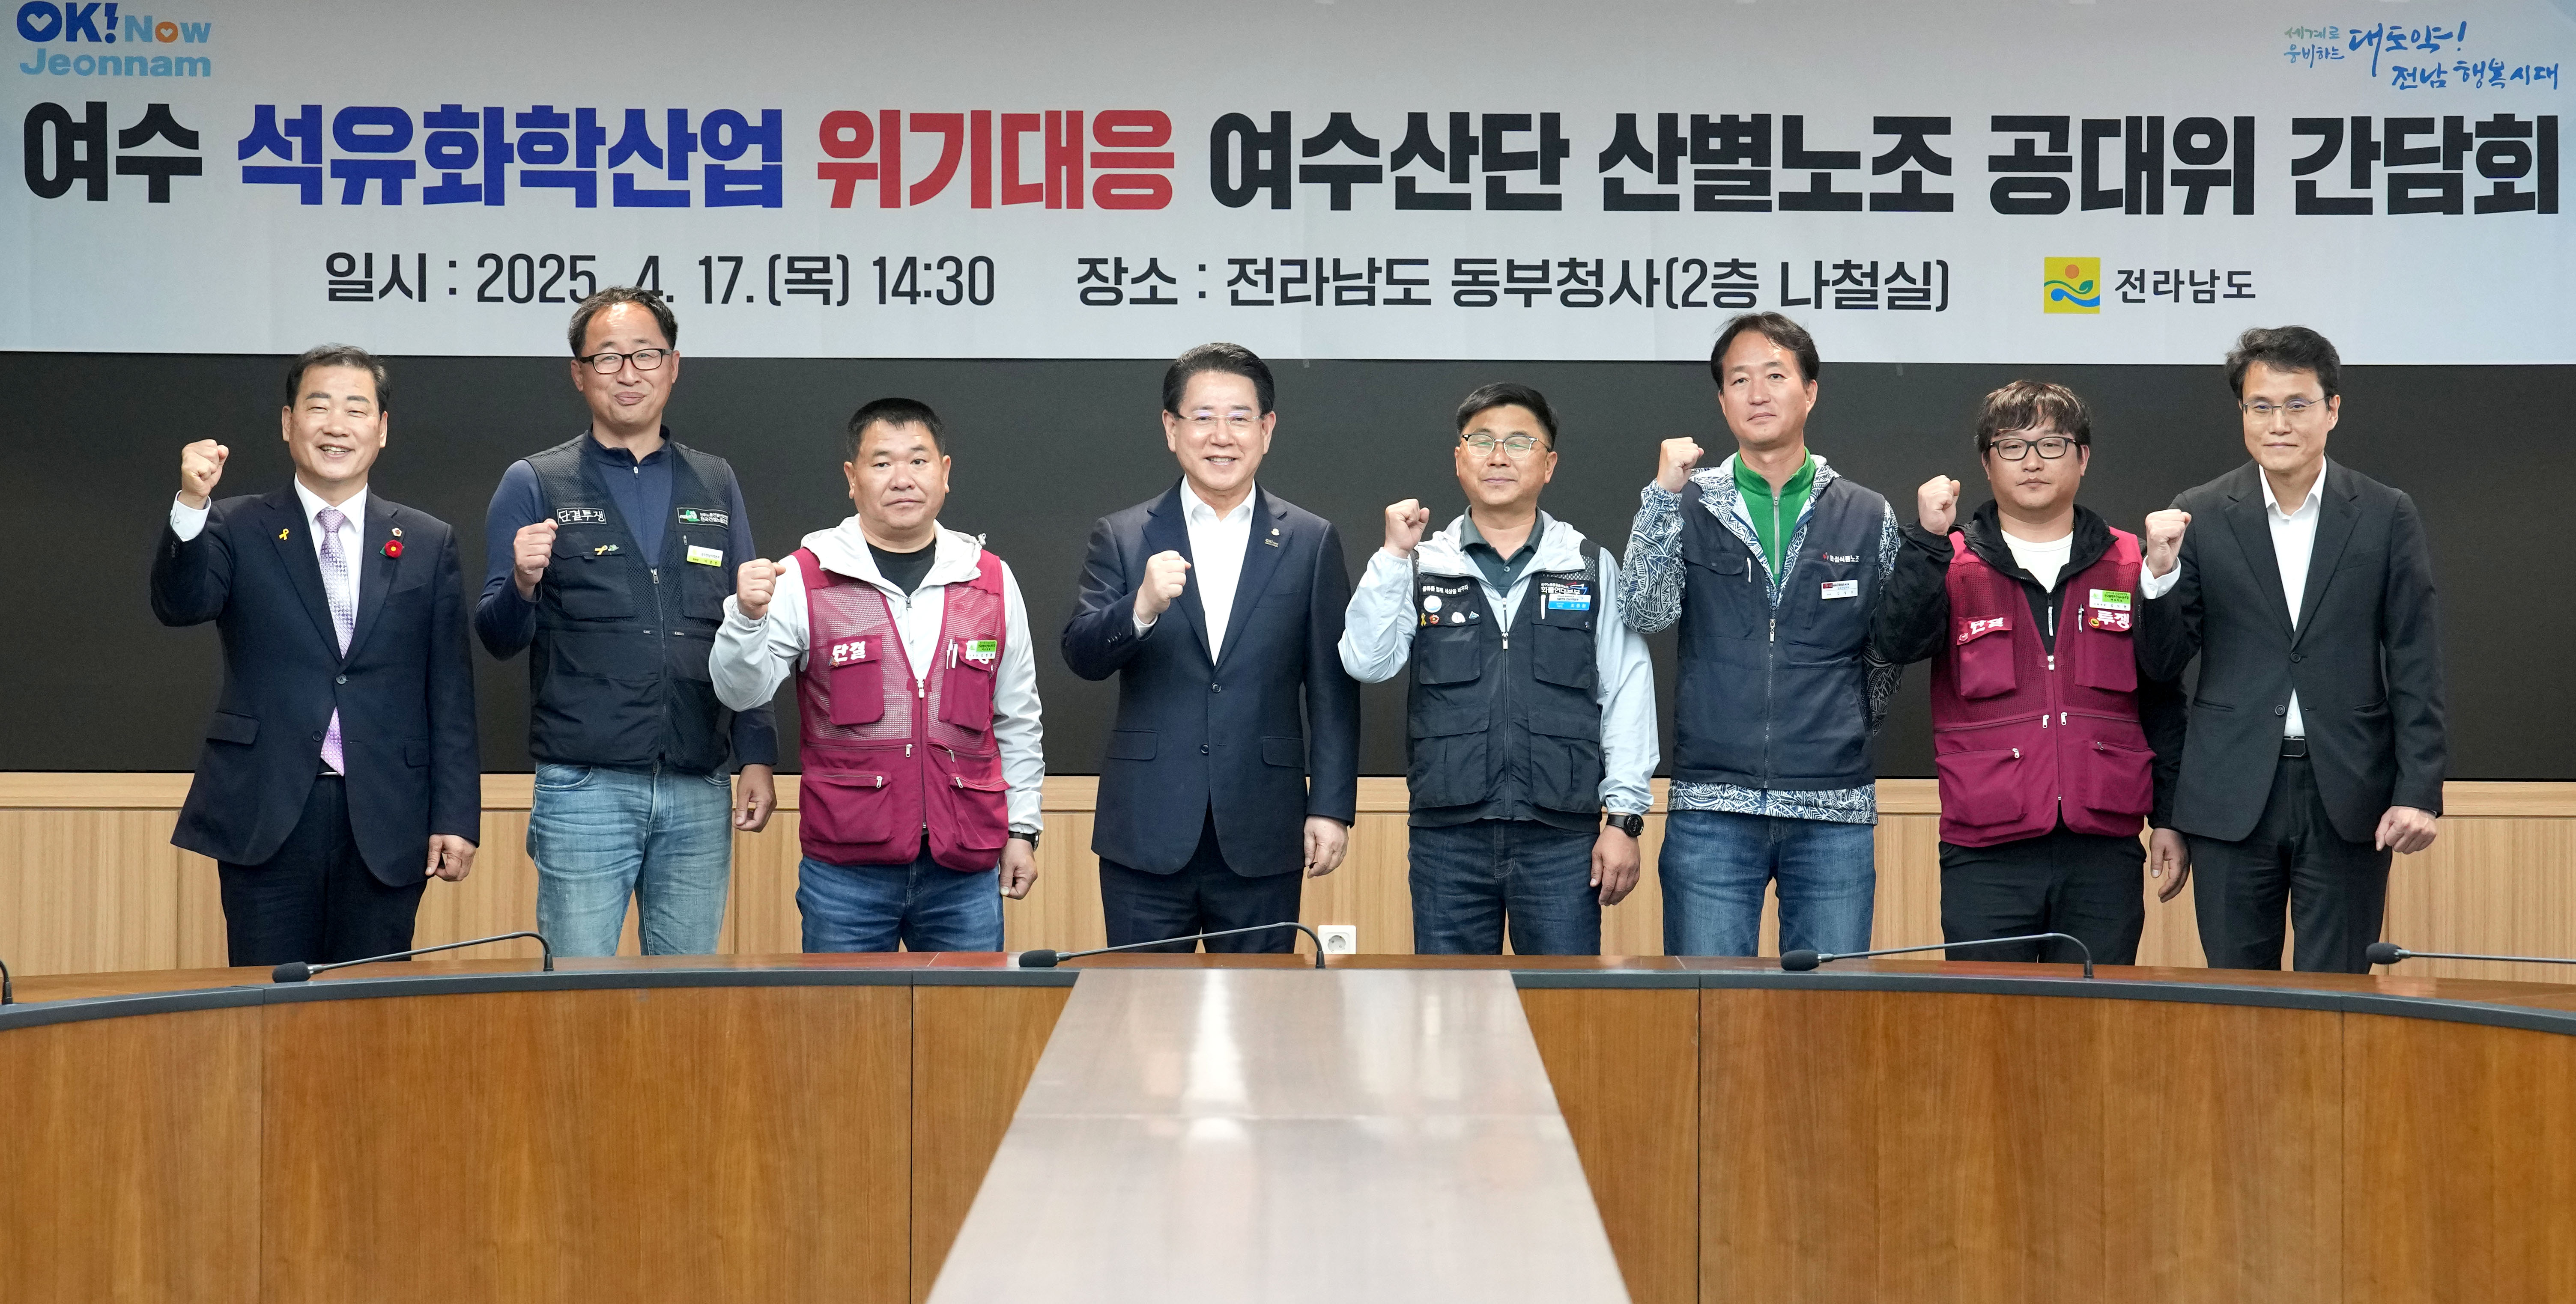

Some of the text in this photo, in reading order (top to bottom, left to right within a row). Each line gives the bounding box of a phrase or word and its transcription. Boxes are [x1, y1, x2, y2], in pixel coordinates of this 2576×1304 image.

[17, 1, 210, 43] OK! Now
[2284, 26, 2340, 39] 세계로
[20, 49, 210, 76] Jeonnam
[2284, 44, 2344, 68] 웅비하는
[2349, 21, 2467, 77] 대도약!
[2392, 63, 2448, 90] 전남
[24, 101, 2558, 215] 여수 석유화학산업 위기대응 여수산단 산별노조 공대위 간담회
[326, 252, 426, 302] 일시
[873, 256, 994, 306] 14:30
[1078, 257, 1178, 306] 장소
[1227, 257, 1431, 306] 전라남도
[1452, 257, 1759, 310] 동부청사(2층
[1780, 259, 1948, 311] 나철실)
[2115, 269, 2256, 304] 전라남도
[558, 509, 605, 523] 단결투쟁
[1970, 617, 2004, 634] 단결
[2097, 610, 2130, 629] 투쟁
[832, 641, 866, 662] 단결
